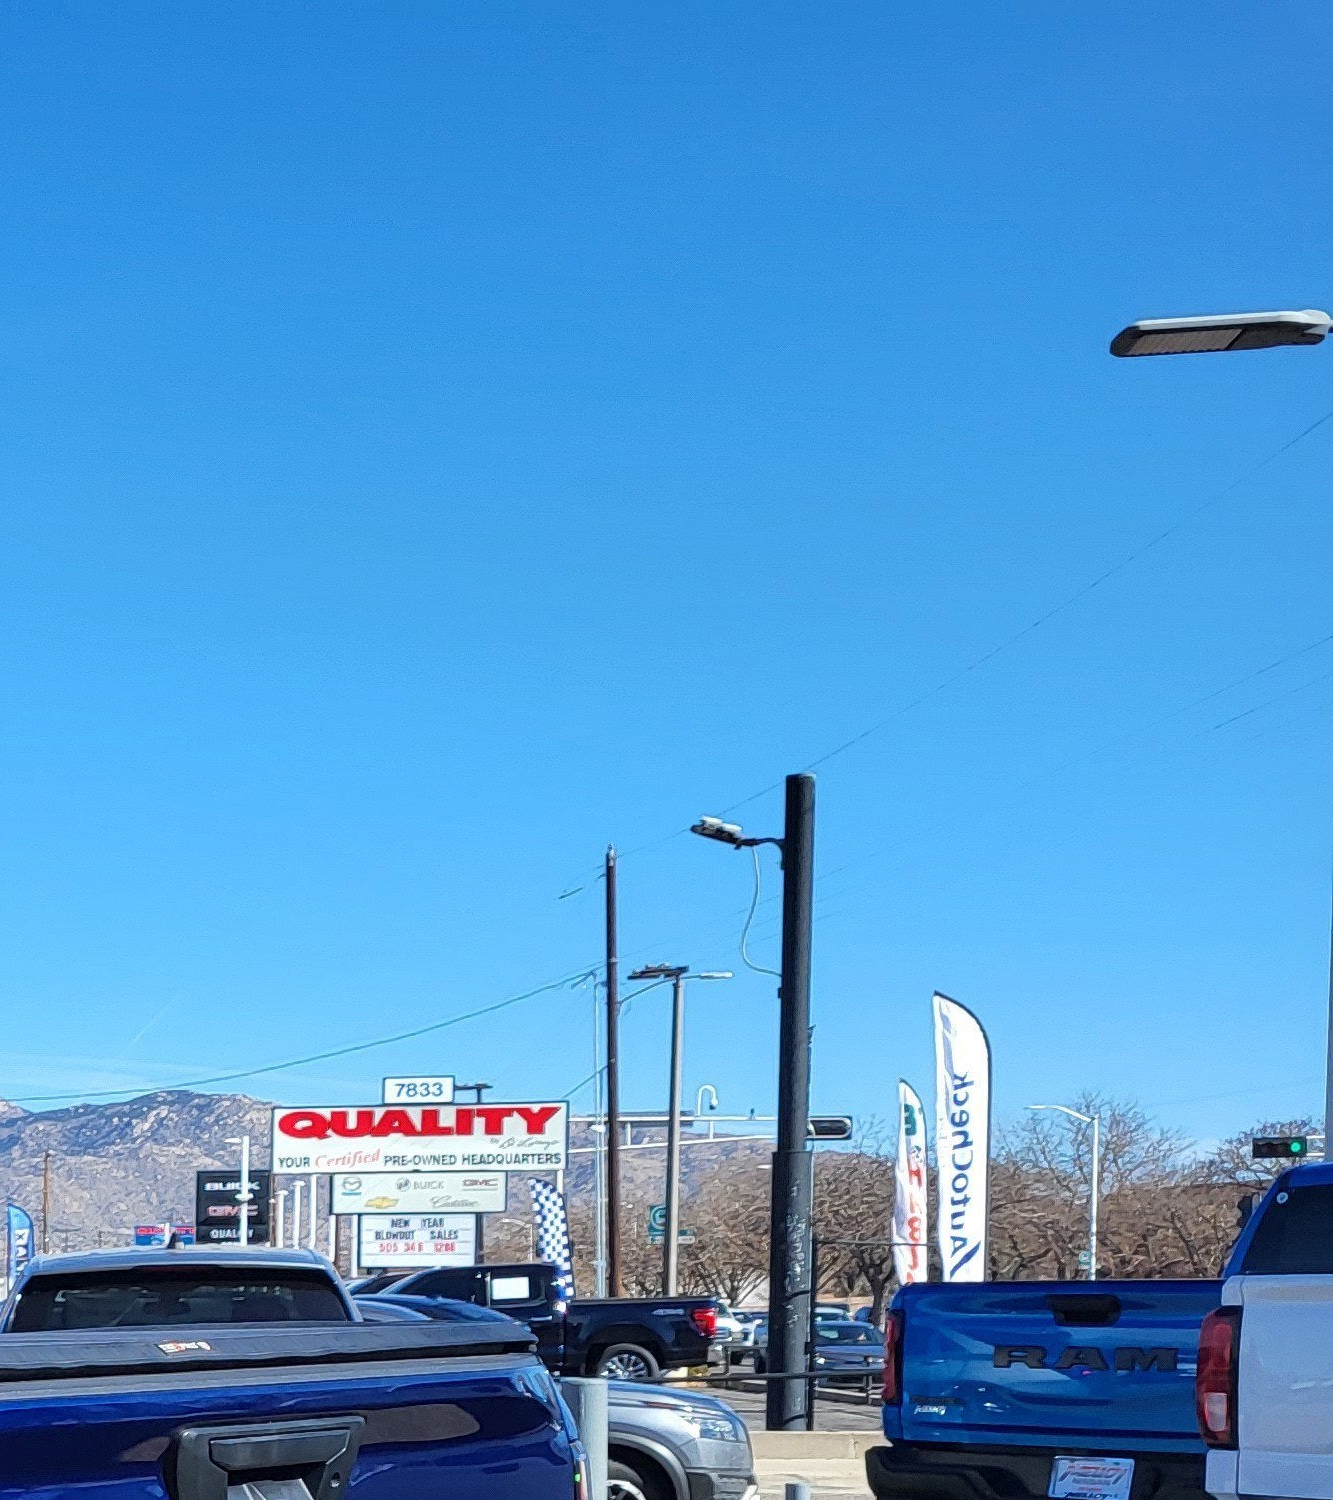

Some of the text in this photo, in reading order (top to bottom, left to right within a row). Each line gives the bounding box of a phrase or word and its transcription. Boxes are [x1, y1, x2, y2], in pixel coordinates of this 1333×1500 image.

[394, 1082, 444, 1098] 7833
[278, 1106, 562, 1140] QUALITY
[278, 1148, 562, 1169] YOUR Certified PRE-OWNED HEADQUARTERS
[210, 1229, 254, 1239] QUALY
[429, 1230, 459, 1240] SALES
[992, 1346, 1179, 1372] RAM
